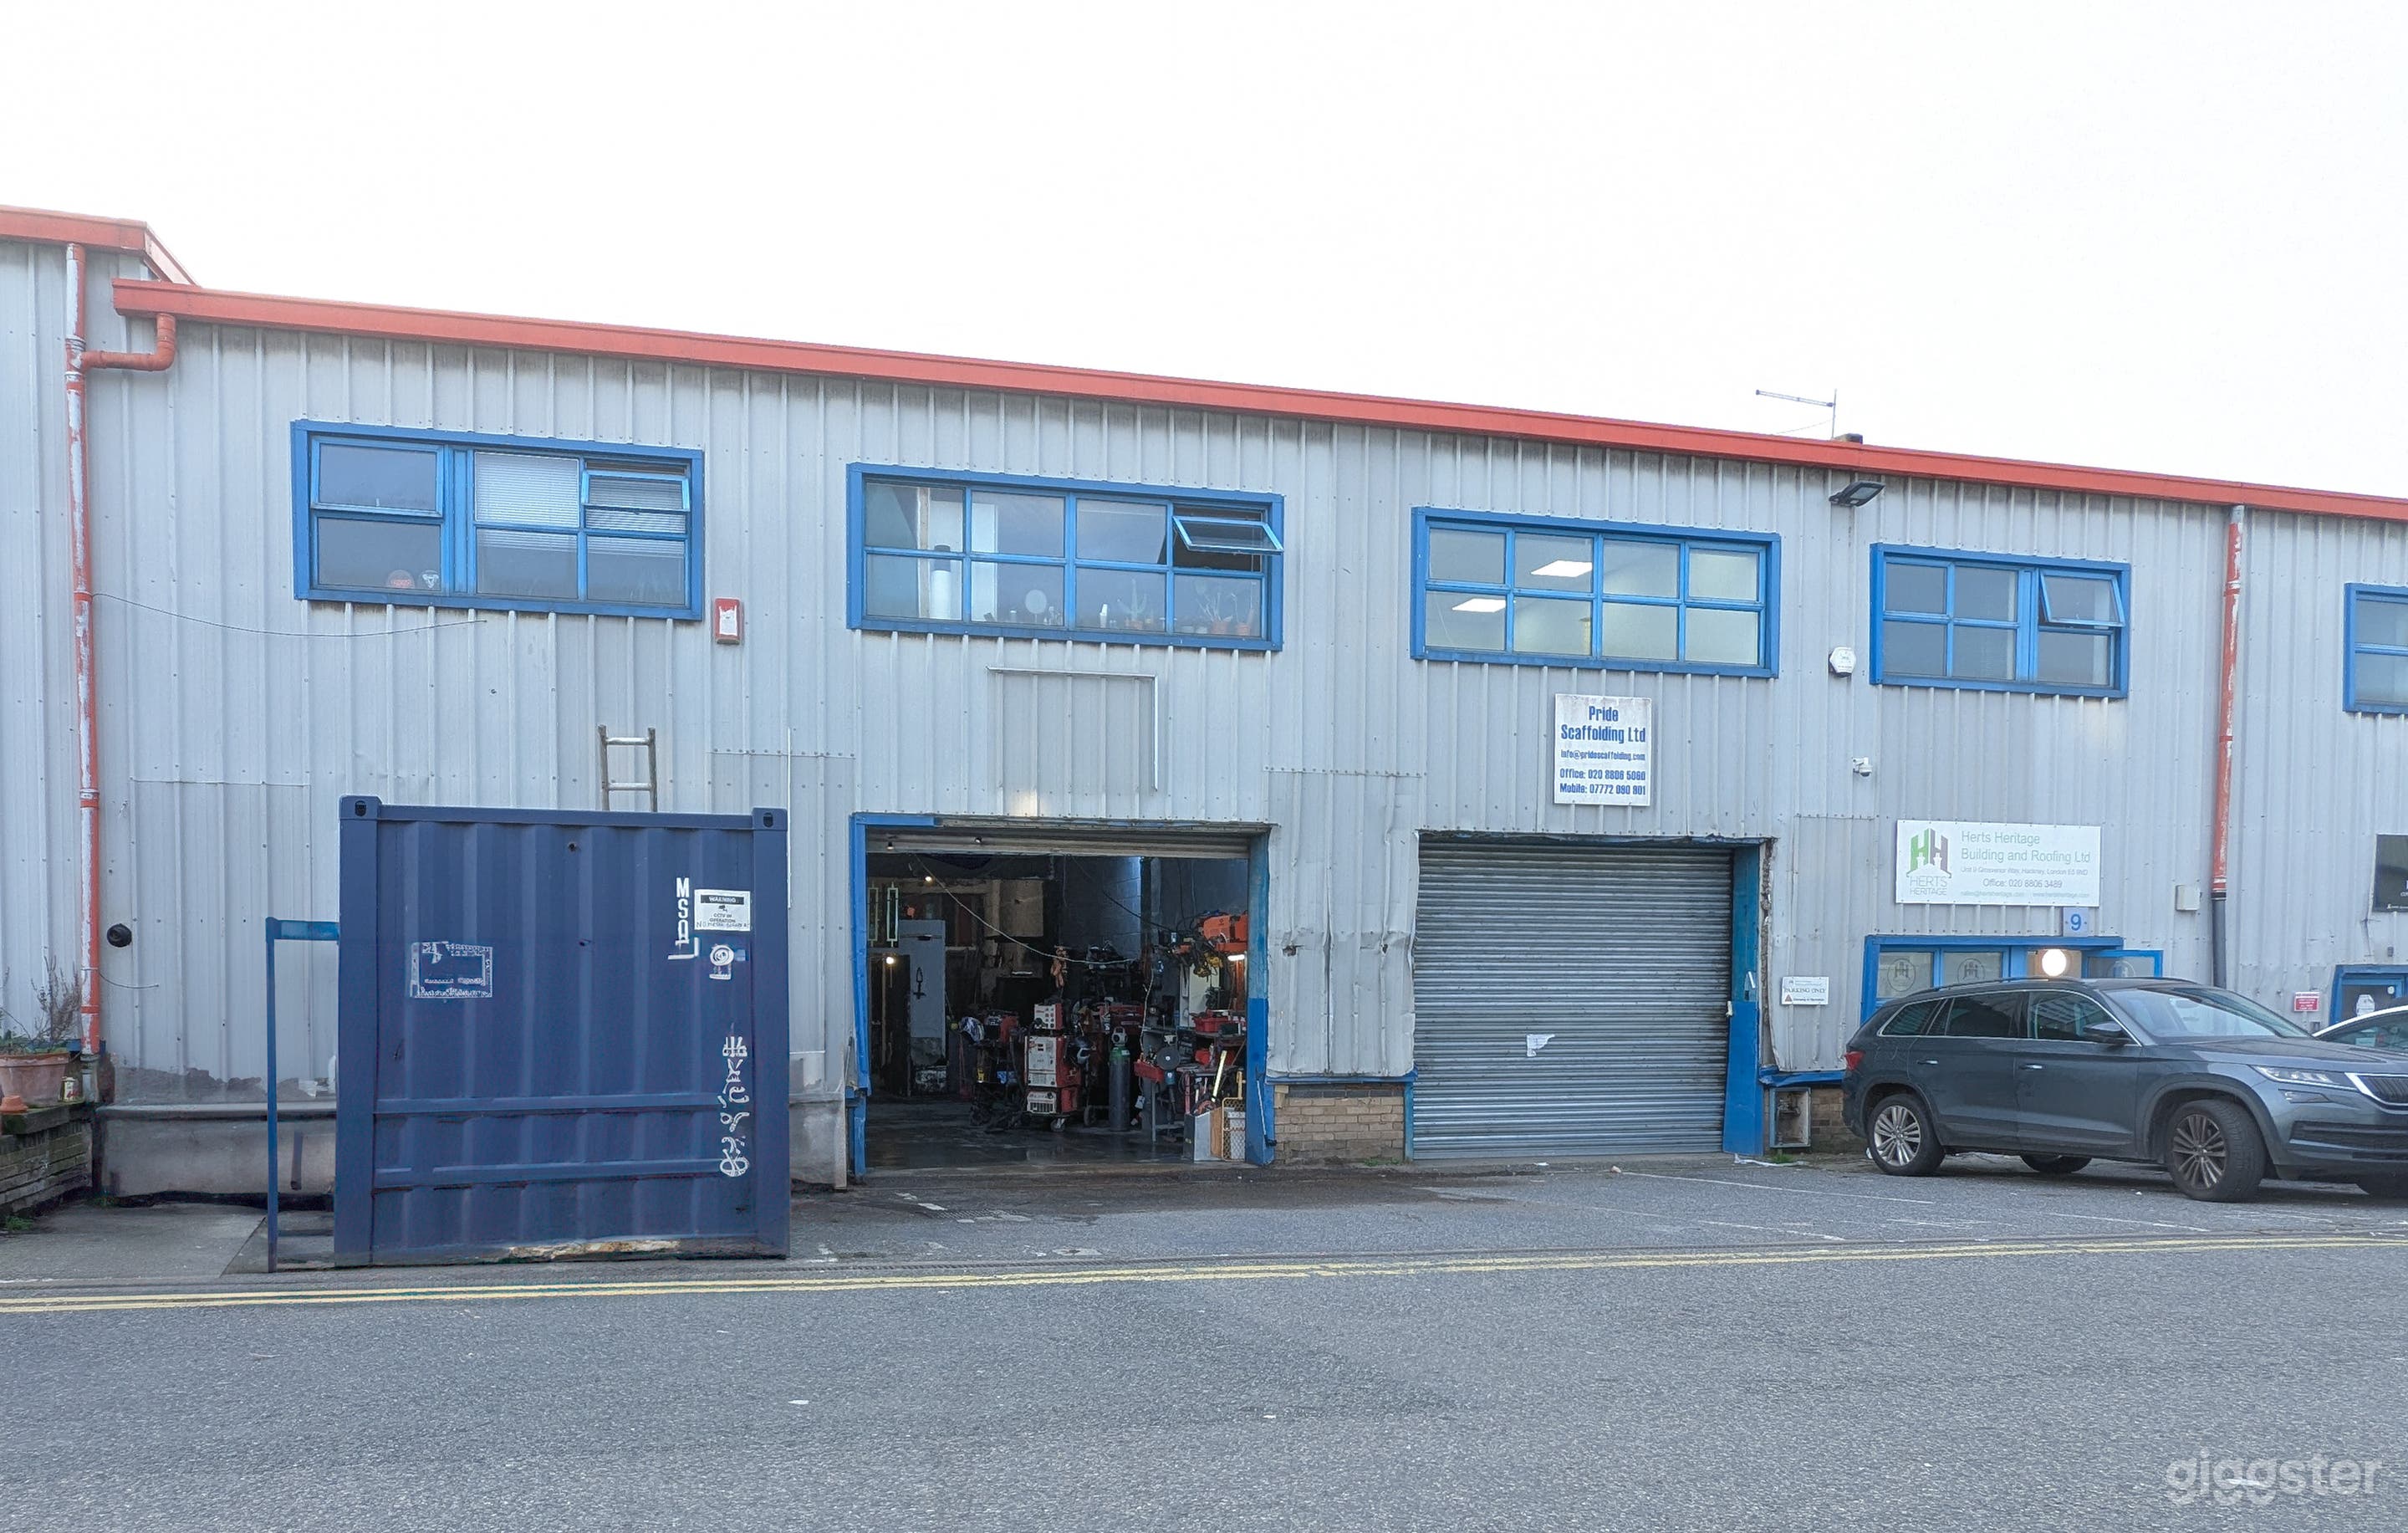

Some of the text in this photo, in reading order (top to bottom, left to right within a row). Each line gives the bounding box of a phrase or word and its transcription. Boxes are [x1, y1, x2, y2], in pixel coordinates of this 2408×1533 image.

[1589, 706, 1619, 722] Pride
[1561, 723, 1645, 744] Scaffolding Ltd
[1559, 768, 1586, 779] Office:
[1588, 769, 1603, 779] 020
[1559, 783, 1588, 794] Mobile:
[1589, 784, 1614, 795] 07772
[1961, 830, 2040, 847] Herts Heritage
[1961, 847, 2090, 865] Building and Roofing Ltd
[1910, 876, 1947, 887] HERTS
[1982, 878, 2007, 887] Office:
[2008, 878, 2023, 887] 020
[2044, 880, 2063, 888] 3489
[1910, 887, 1947, 896] HERITAGE
[2071, 913, 2081, 931] 9
